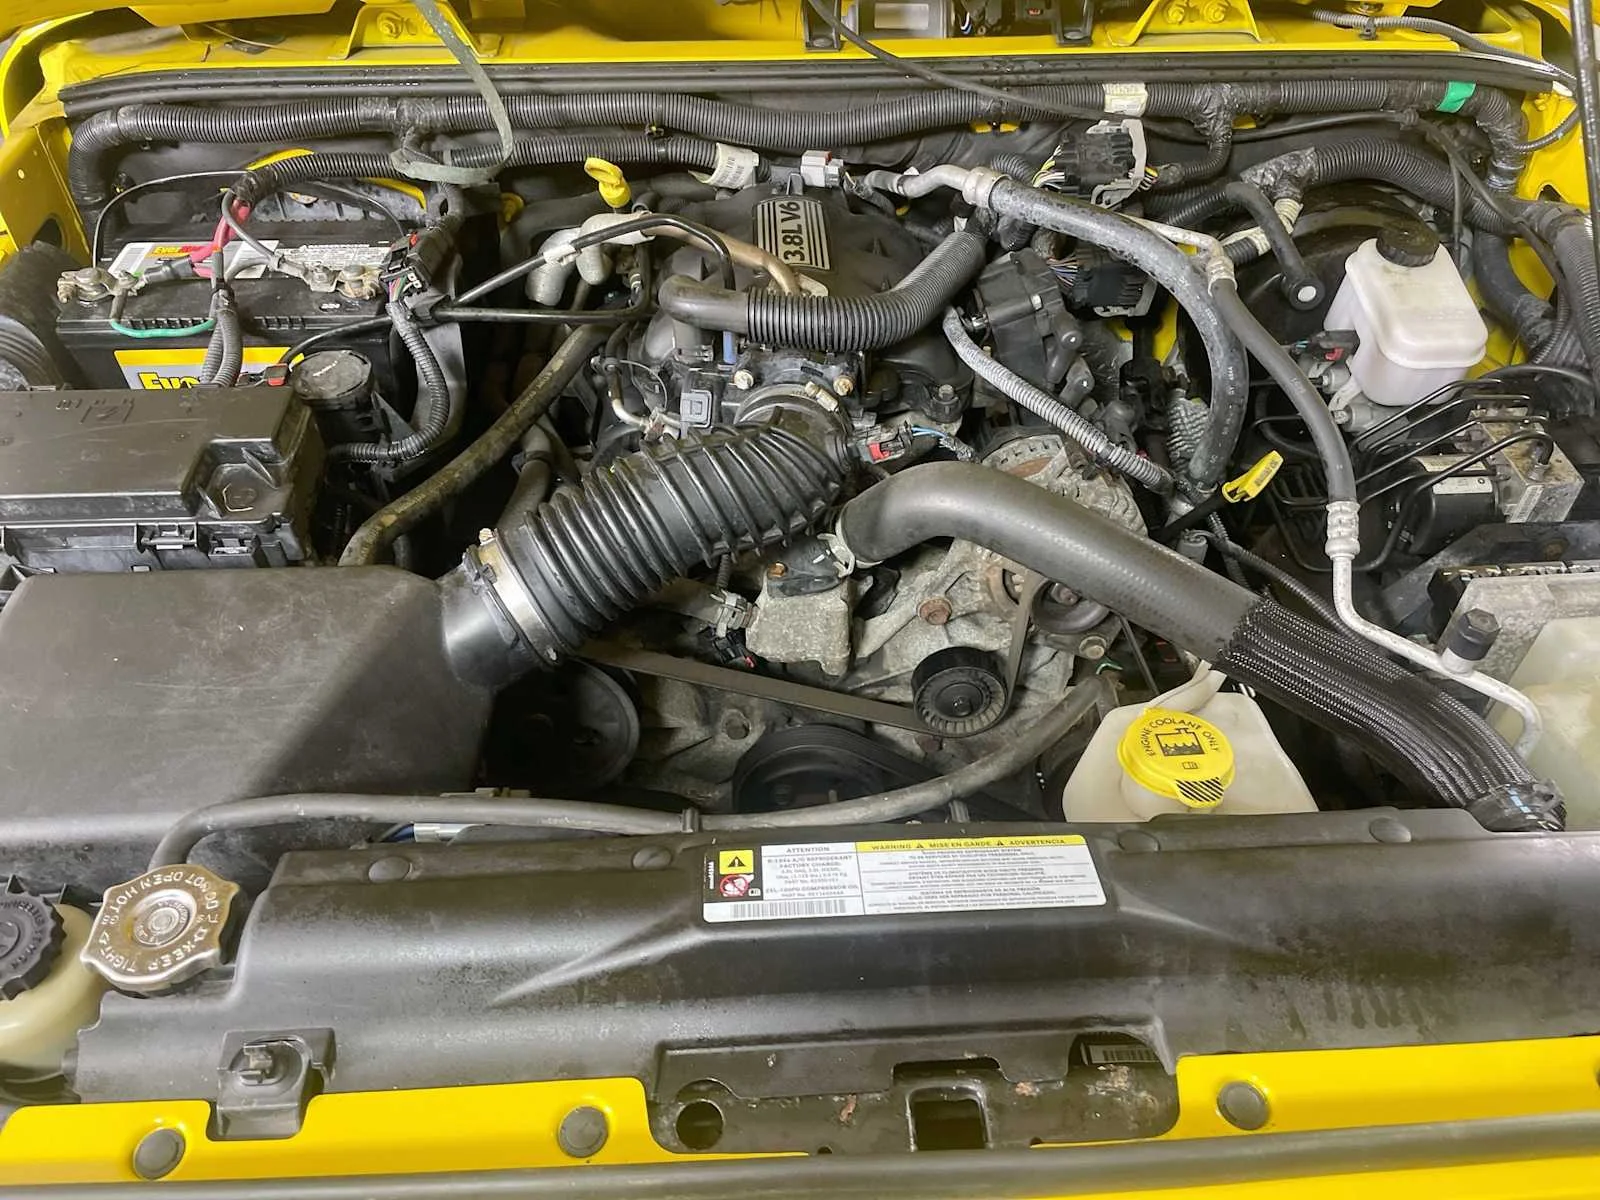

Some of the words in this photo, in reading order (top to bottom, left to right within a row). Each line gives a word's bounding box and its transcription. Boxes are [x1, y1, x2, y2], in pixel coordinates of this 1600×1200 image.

[779, 201, 801, 223] V6
[781, 223, 805, 261] 3.8L
[1141, 727, 1156, 756] ENGINE
[1149, 718, 1202, 730] COOLANT
[1202, 731, 1219, 751] ONLY
[140, 871, 183, 889] OPEN
[110, 886, 139, 913] HOT
[148, 940, 197, 971] KEEP
